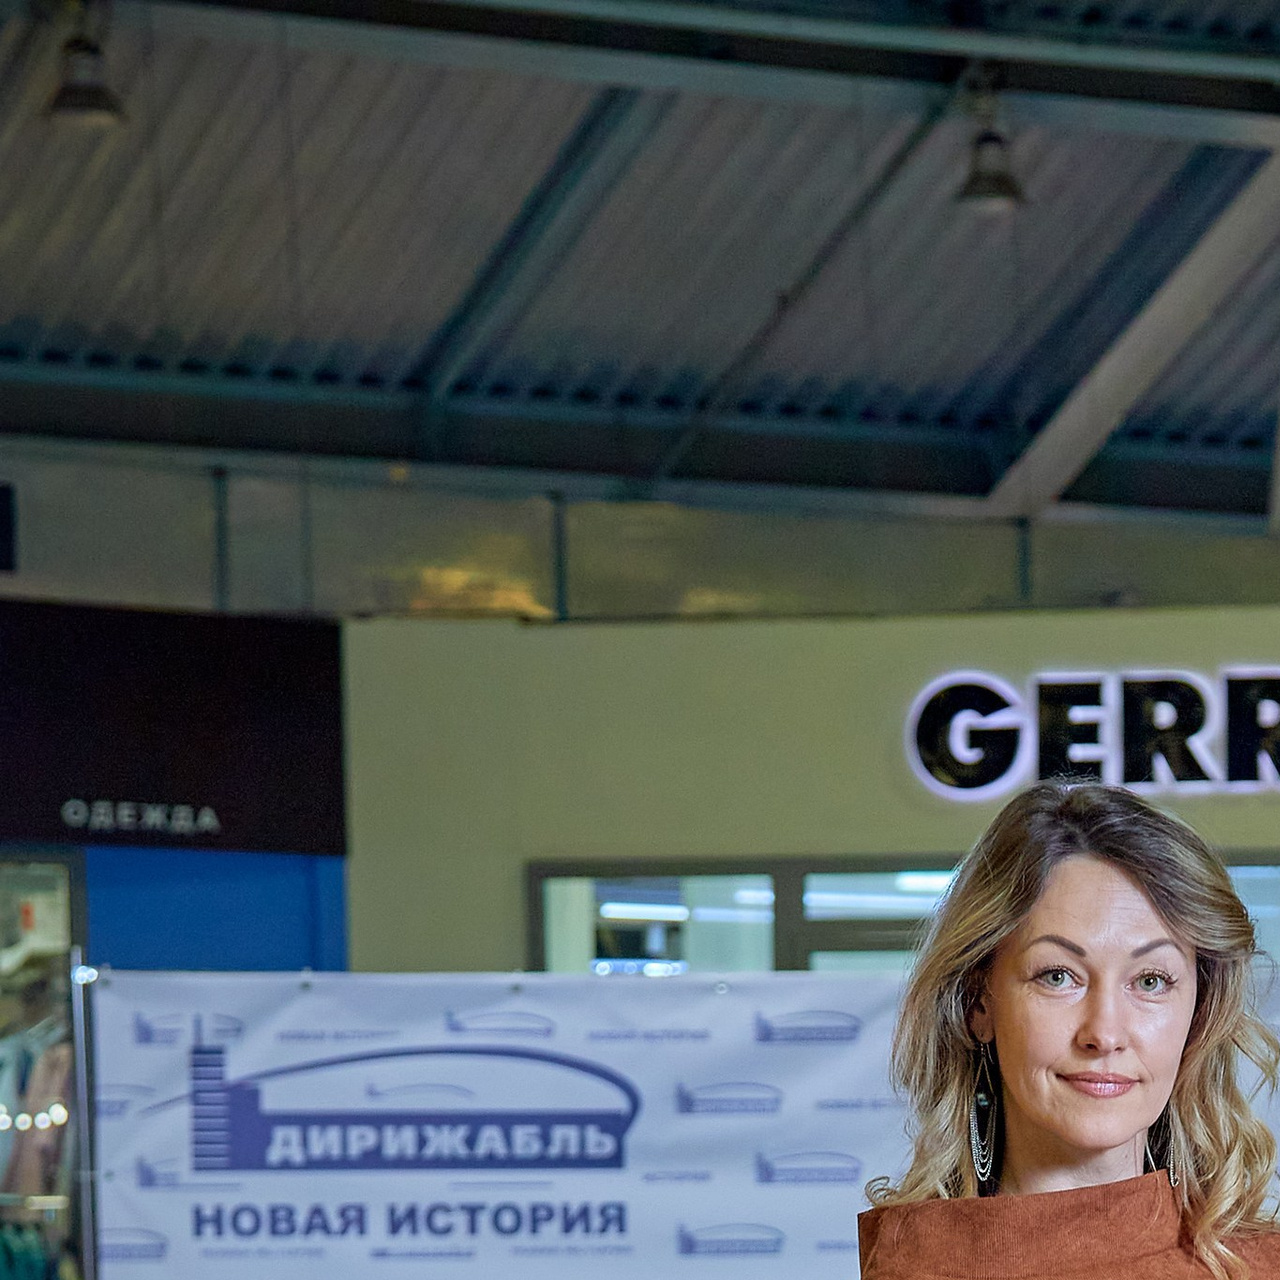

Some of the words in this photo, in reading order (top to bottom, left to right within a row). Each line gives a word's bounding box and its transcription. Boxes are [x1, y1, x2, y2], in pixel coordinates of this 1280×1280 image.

[60, 799, 221, 834] ОДЕЖДА
[265, 1123, 619, 1168] ДИРИЖАБЛЬ
[192, 1202, 367, 1238] НОВАЯ
[388, 1200, 628, 1236] ИСТОРИЯ
